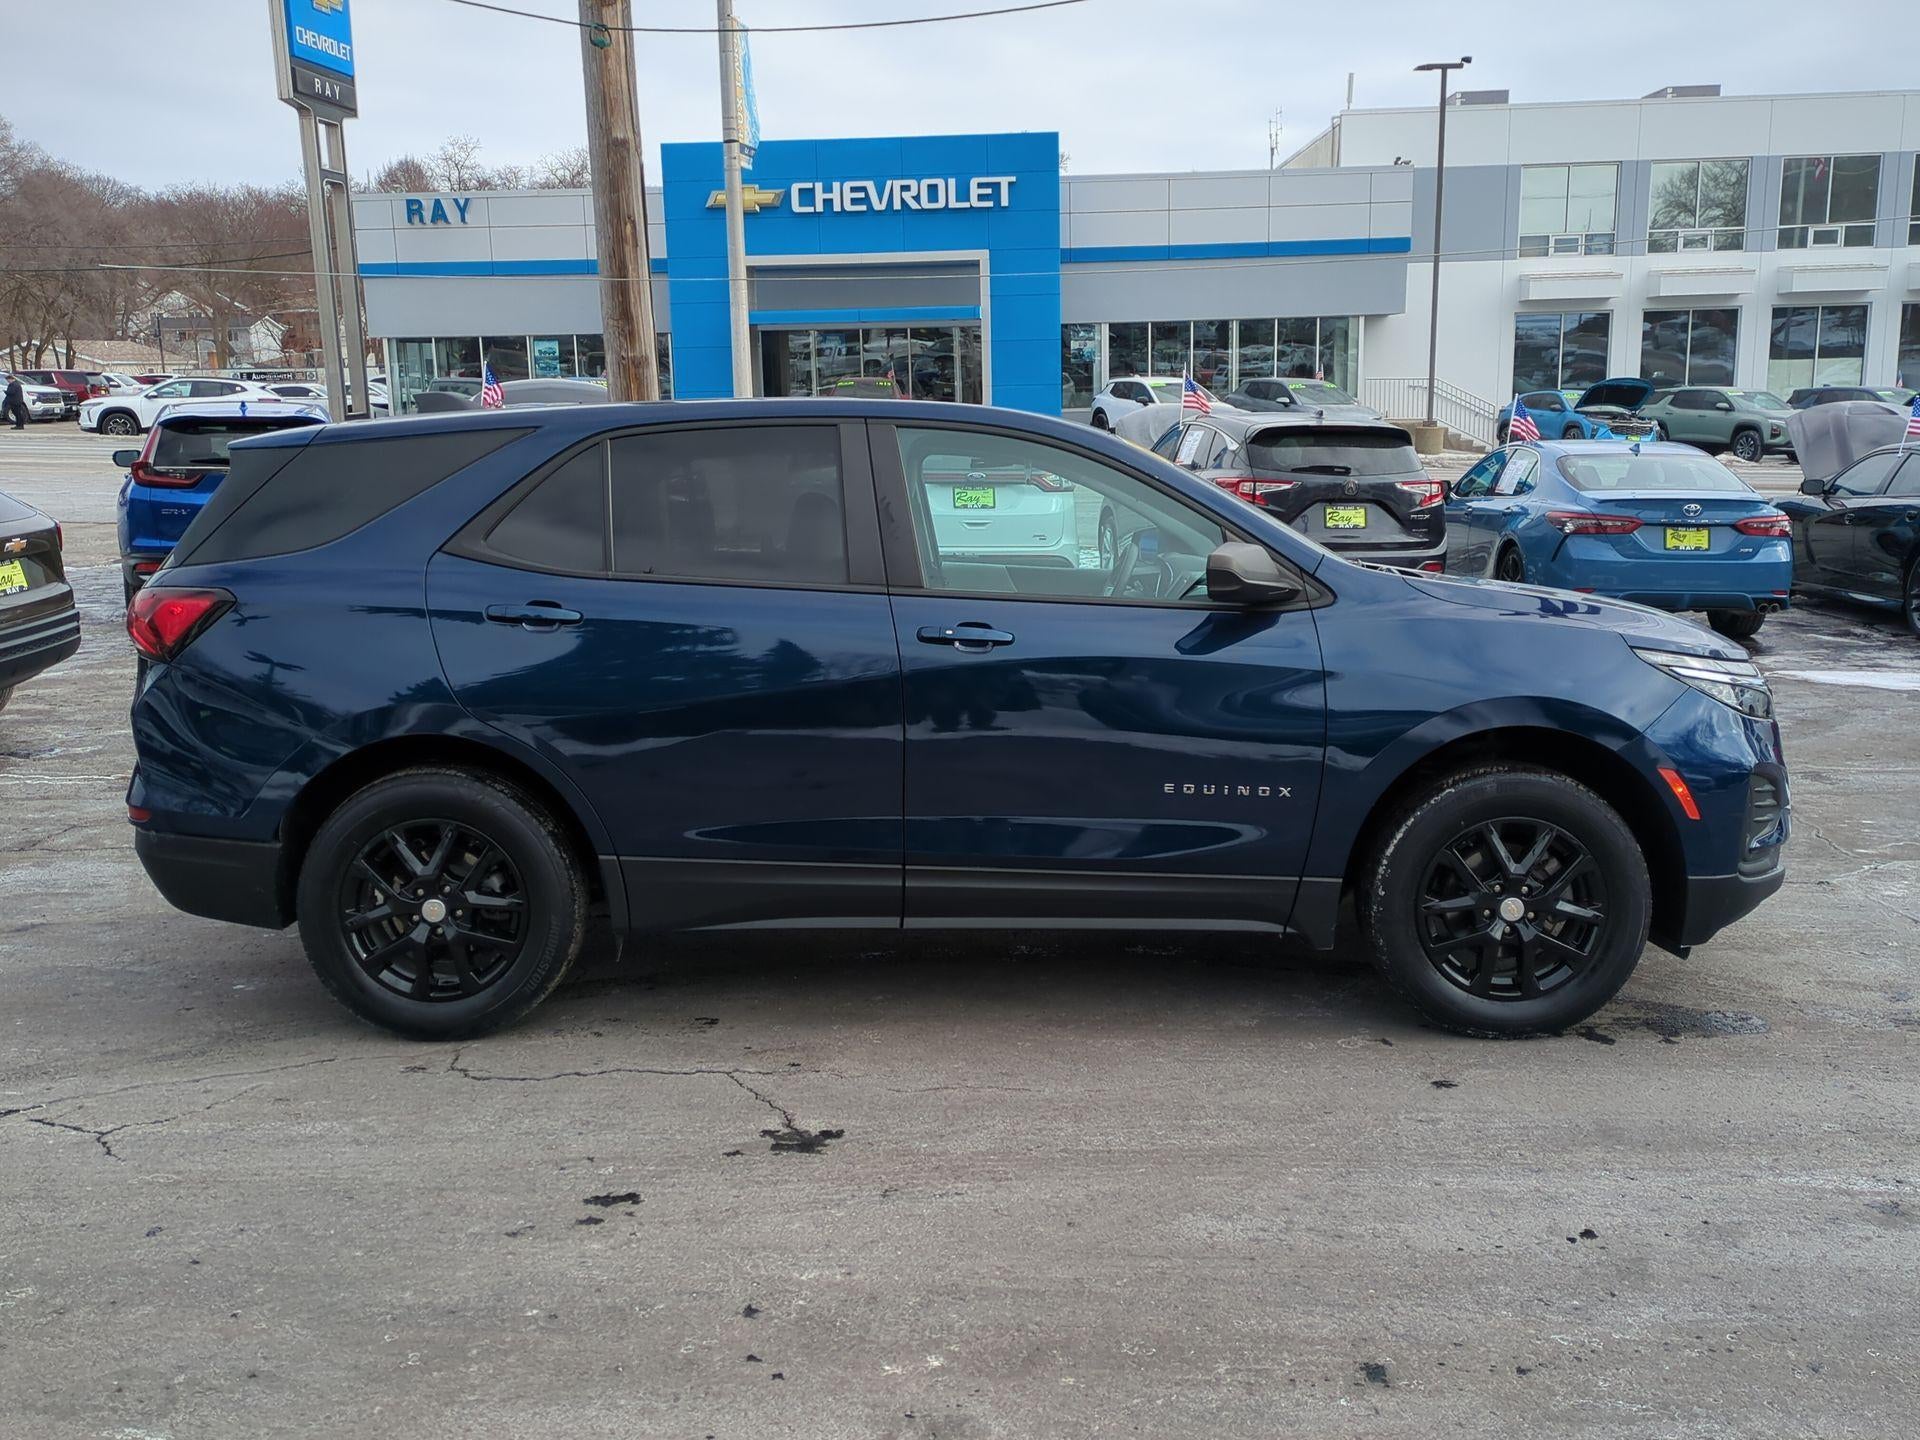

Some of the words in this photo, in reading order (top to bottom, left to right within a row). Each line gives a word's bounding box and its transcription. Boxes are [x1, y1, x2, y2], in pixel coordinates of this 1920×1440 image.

[295, 26, 351, 61] CHEVROLET
[314, 78, 340, 100] RAY
[791, 176, 1017, 213] CHEVROLET
[405, 198, 470, 225] RAY
[1328, 511, 1352, 525] Ray
[0, 574, 14, 587] ay
[1163, 783, 1293, 798] EQUINOX
